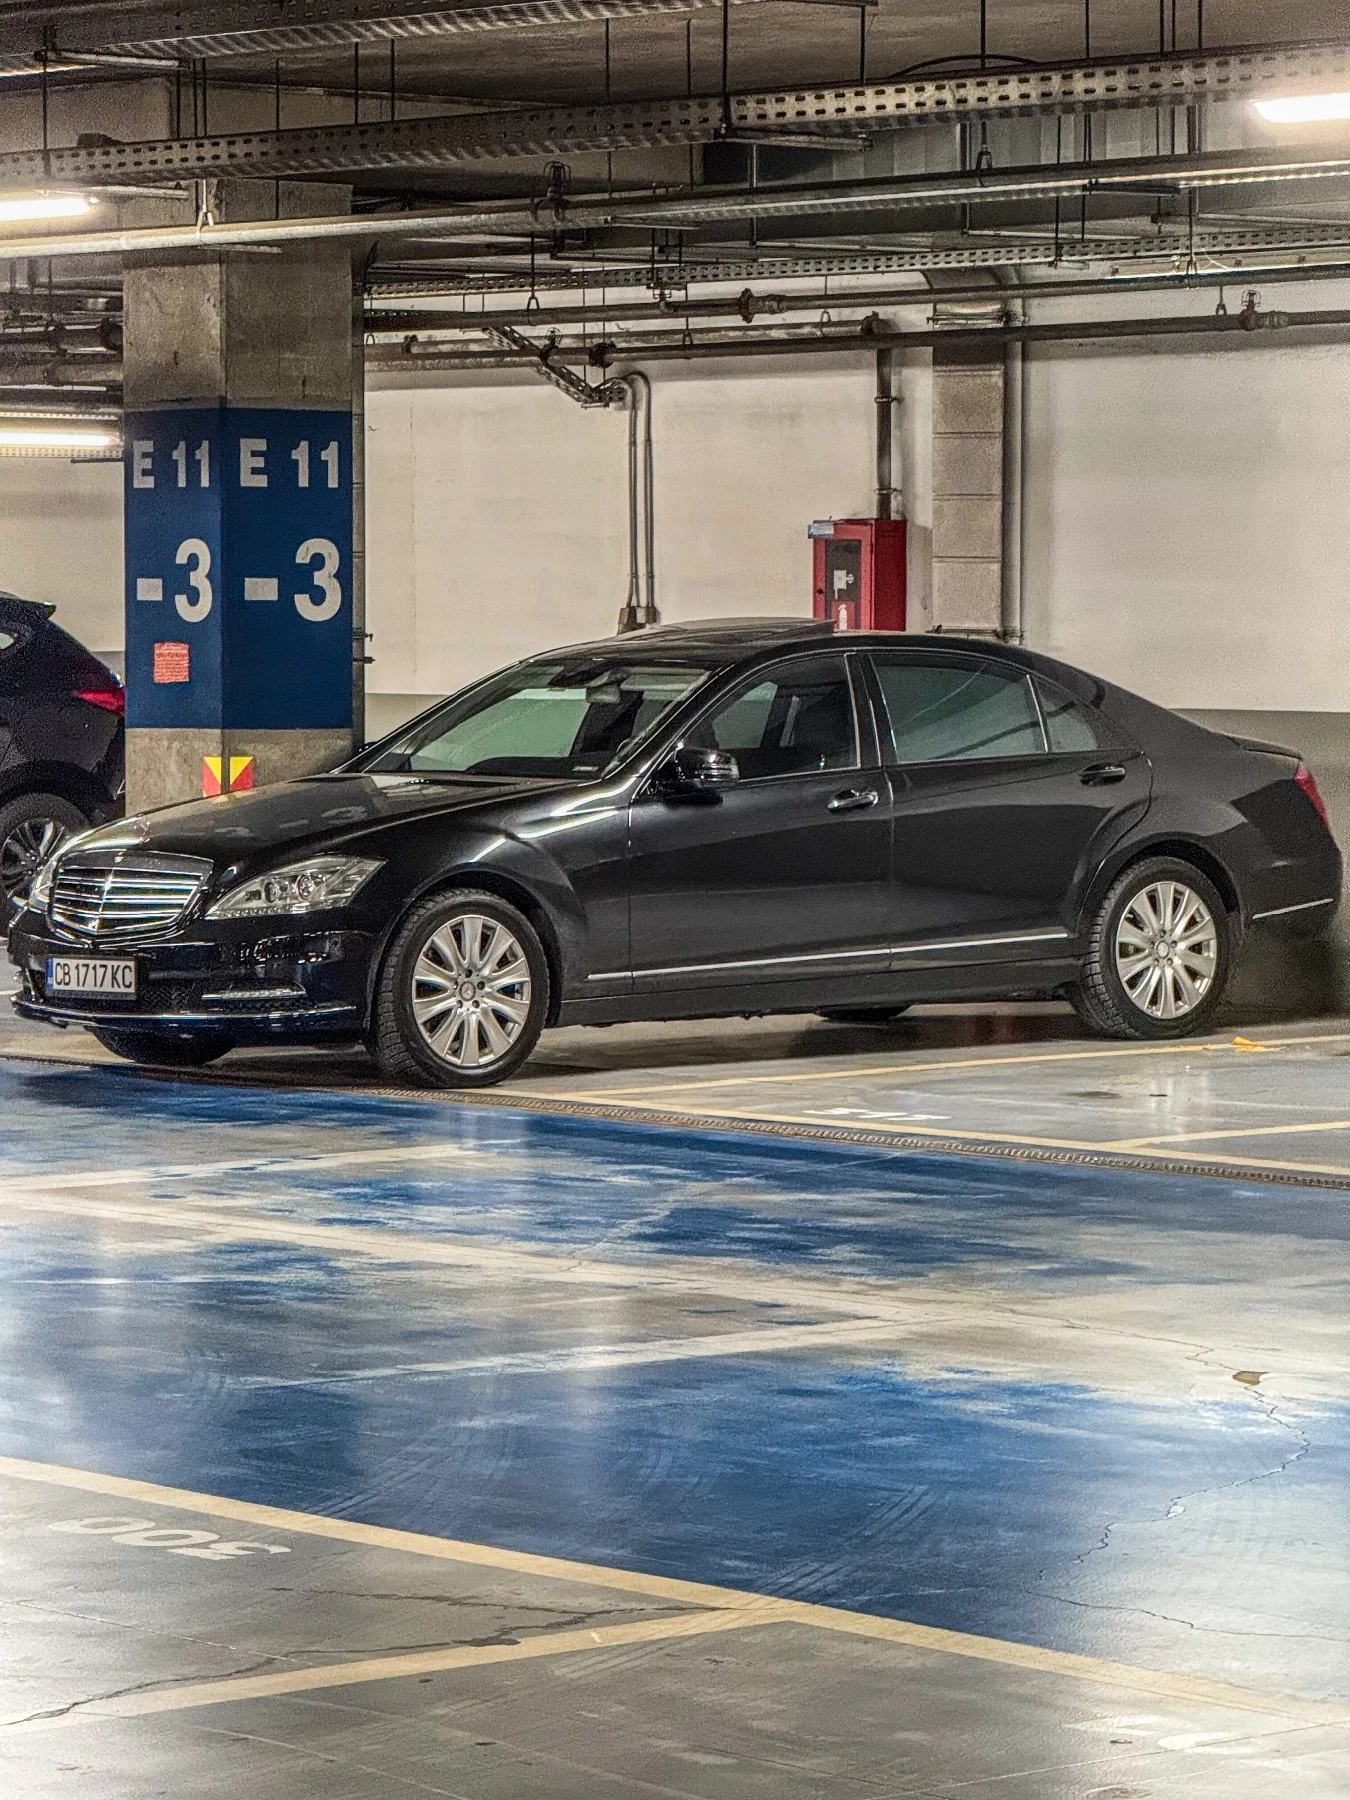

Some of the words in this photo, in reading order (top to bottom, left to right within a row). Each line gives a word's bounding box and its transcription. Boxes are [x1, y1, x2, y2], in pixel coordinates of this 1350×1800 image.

[133, 440, 154, 488] E
[172, 440, 209, 487] 11
[240, 438, 268, 487] E
[291, 440, 339, 488] 11
